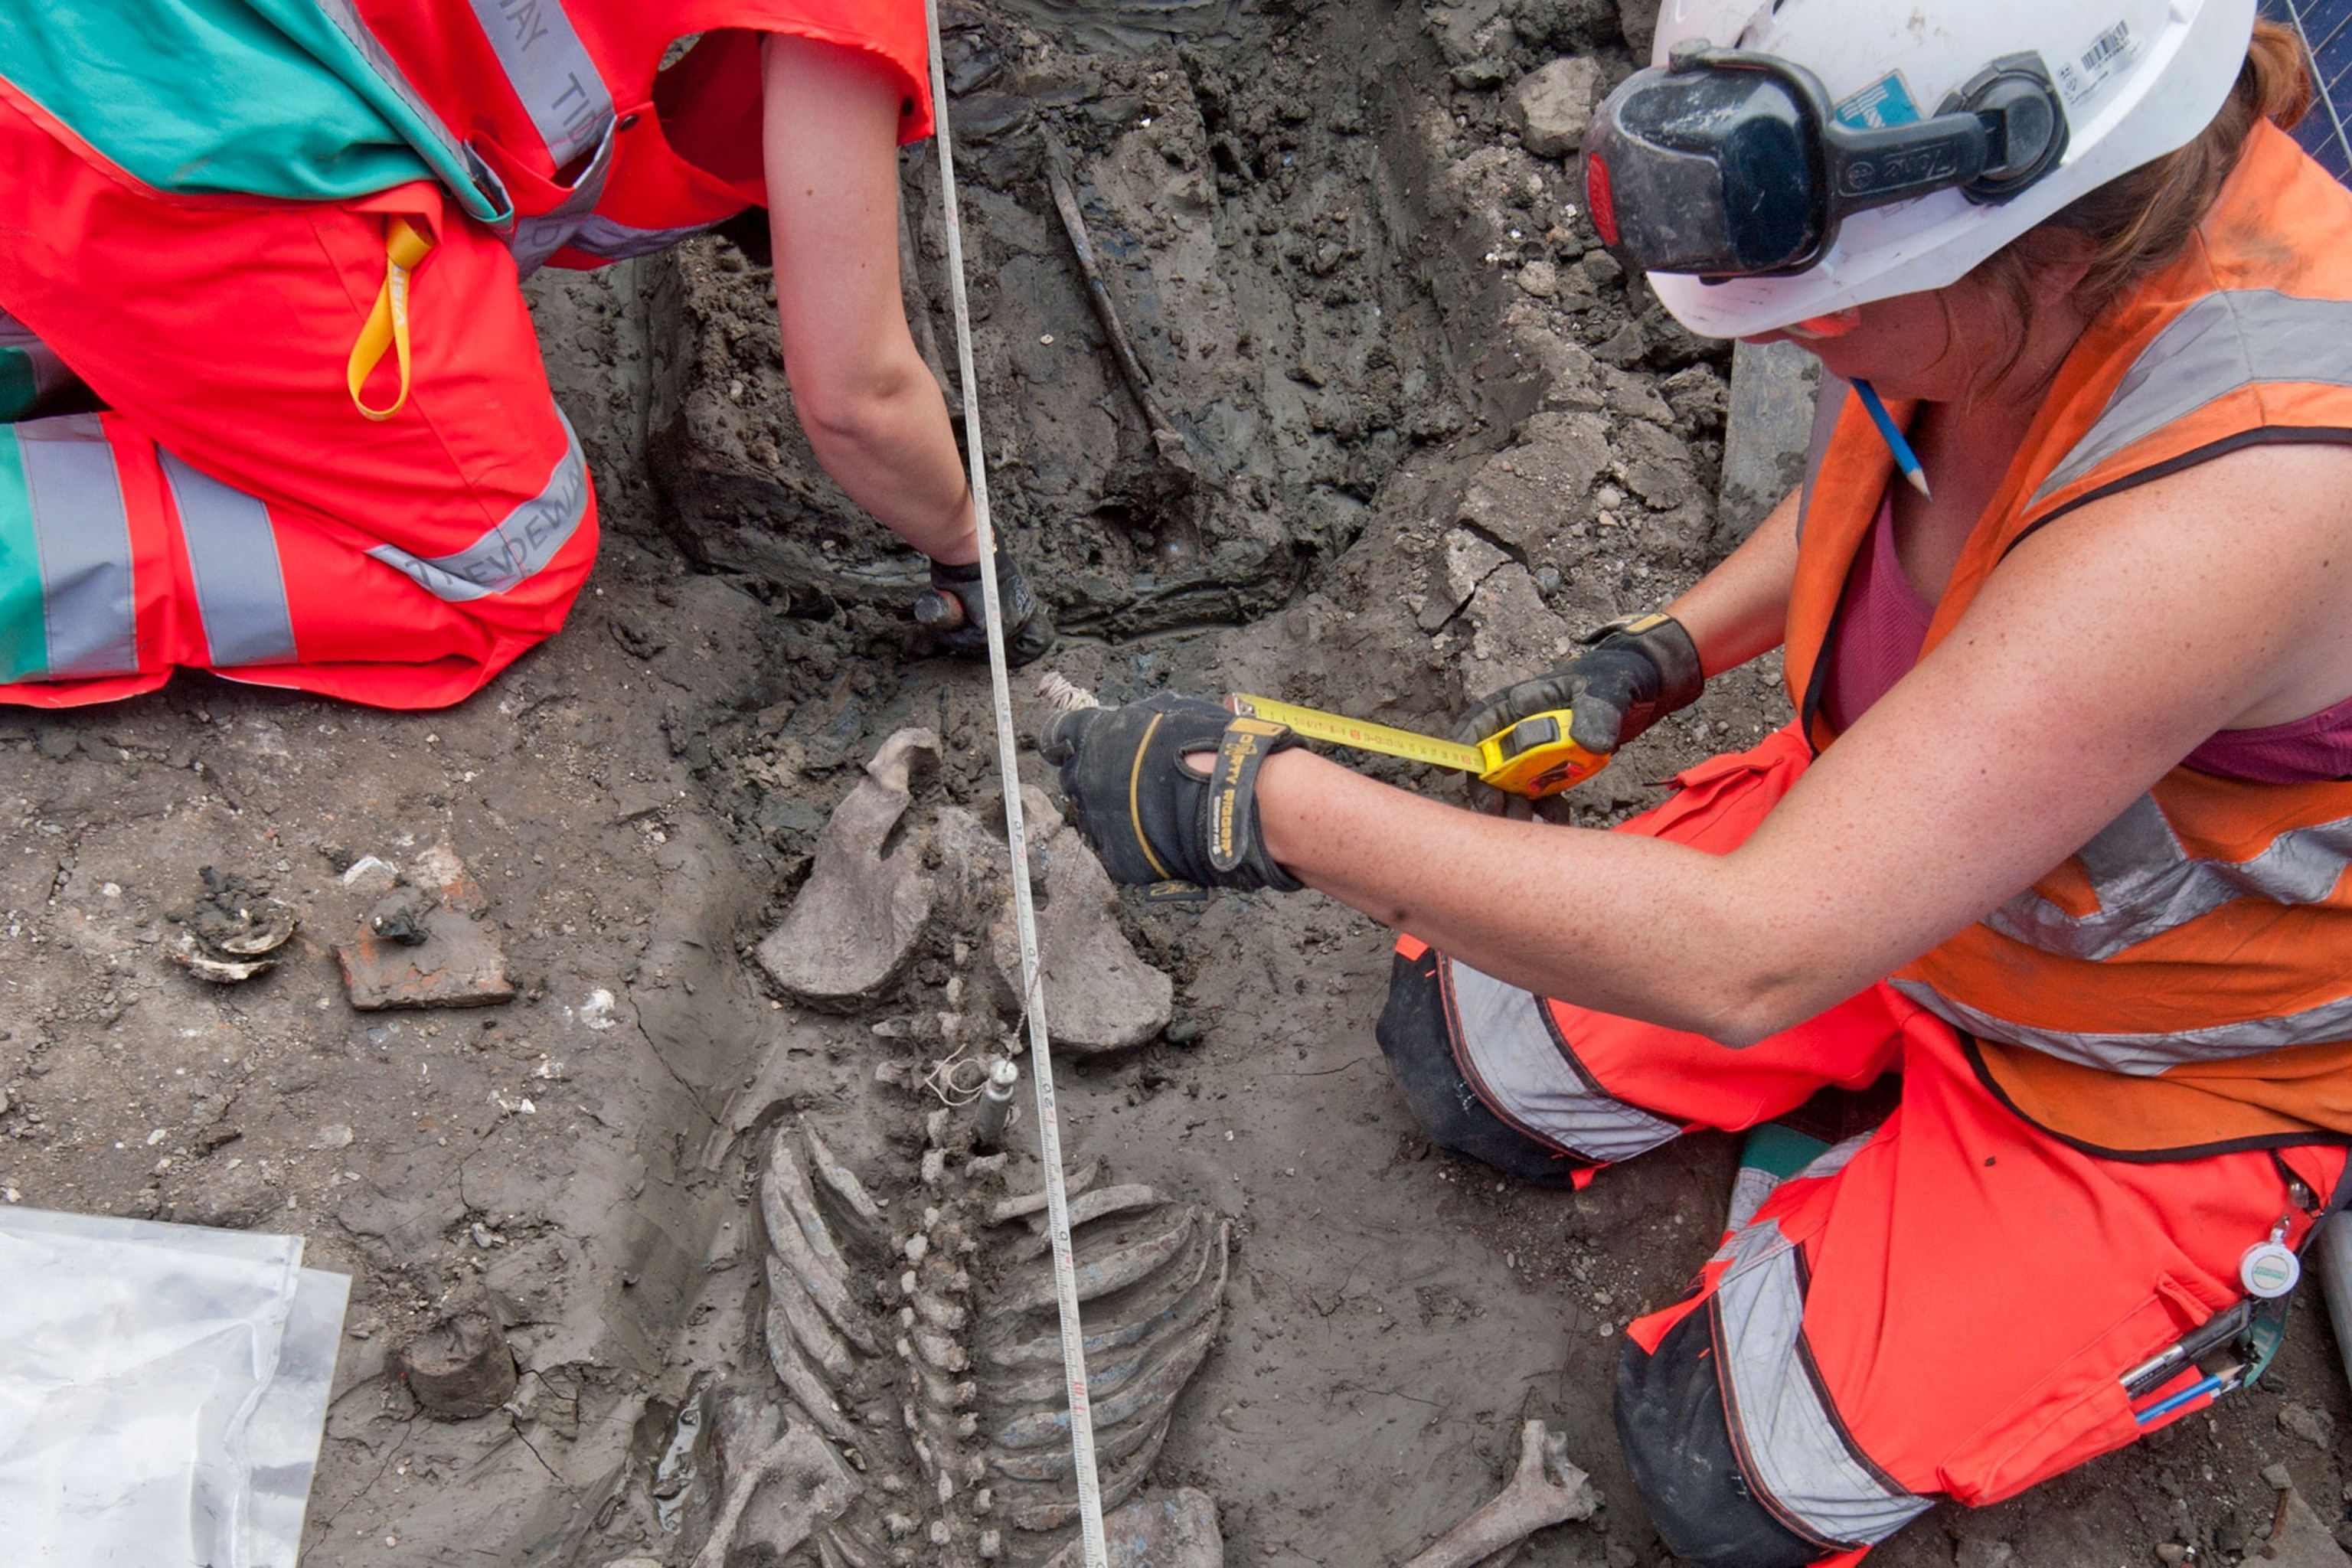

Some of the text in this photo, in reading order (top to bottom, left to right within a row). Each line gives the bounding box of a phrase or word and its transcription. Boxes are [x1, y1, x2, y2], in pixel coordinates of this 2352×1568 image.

[500, 0, 549, 53] AY
[1014, 820, 1024, 841] 40
[1044, 1083, 1054, 1108] 20
